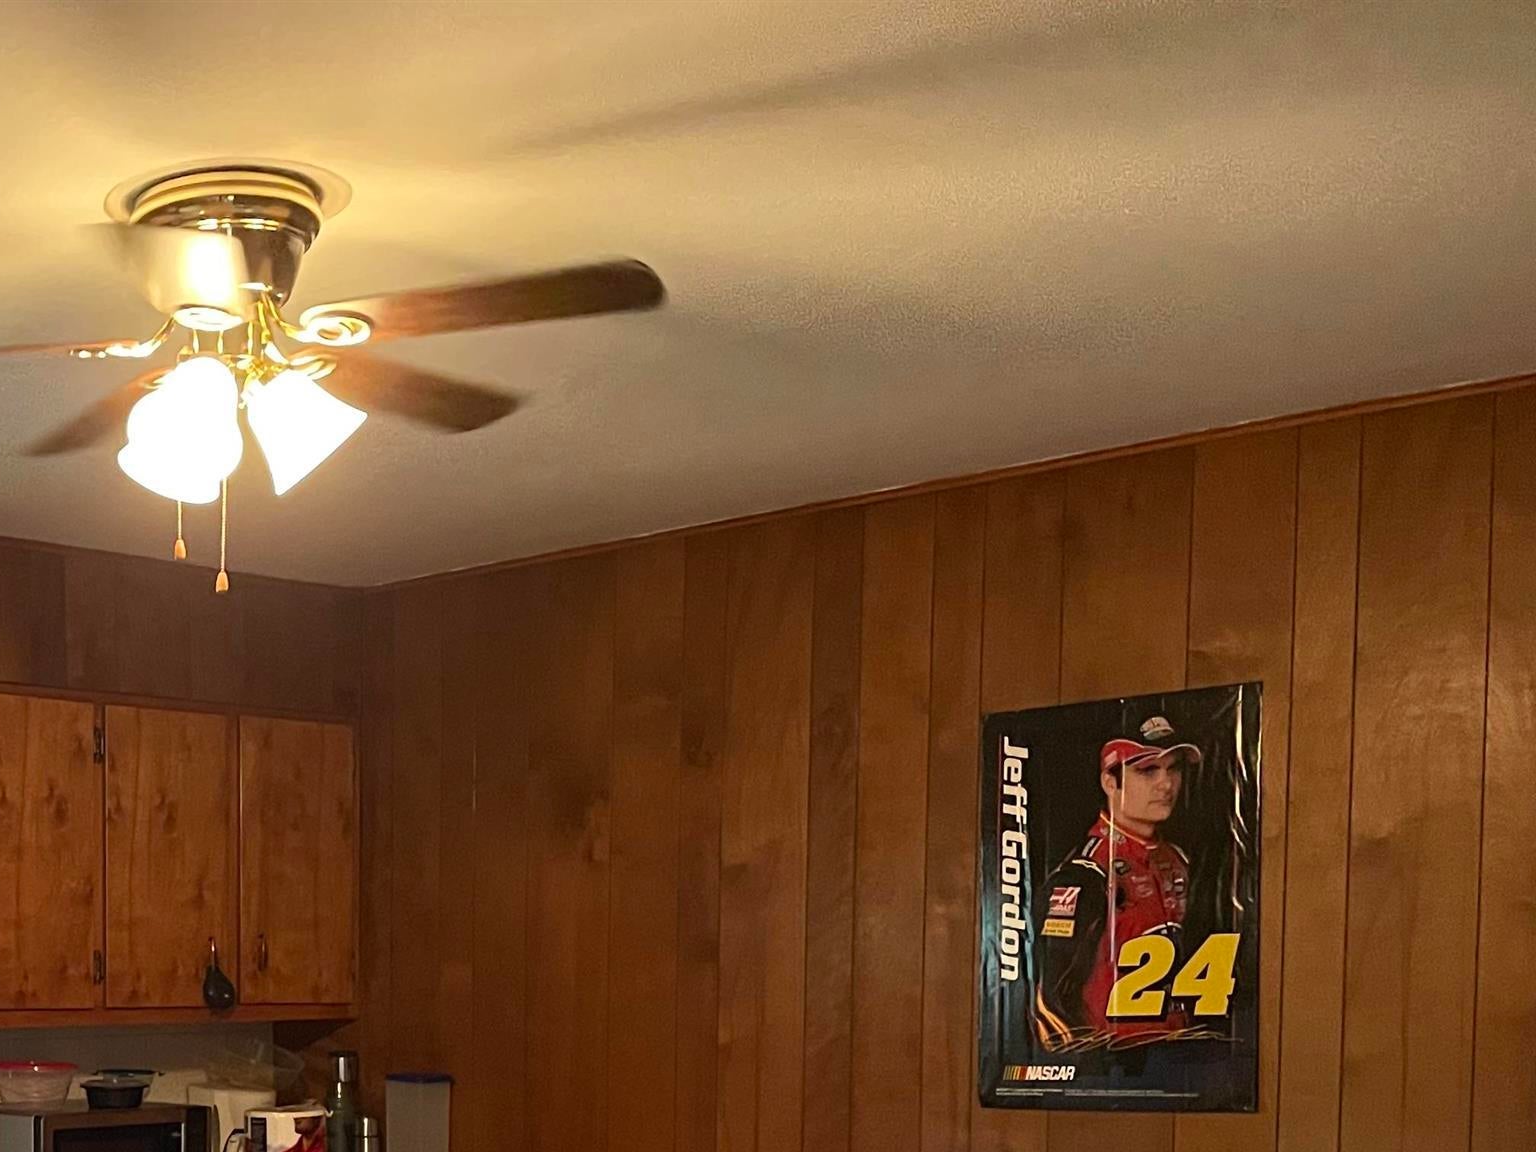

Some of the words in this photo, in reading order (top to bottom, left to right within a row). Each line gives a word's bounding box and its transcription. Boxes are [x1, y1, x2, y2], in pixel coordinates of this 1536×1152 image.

[1003, 736, 1029, 826] Jeff
[1001, 829, 1028, 982] Gordon
[1105, 933, 1241, 1017] 24
[1025, 1065, 1076, 1081] NASCAR
